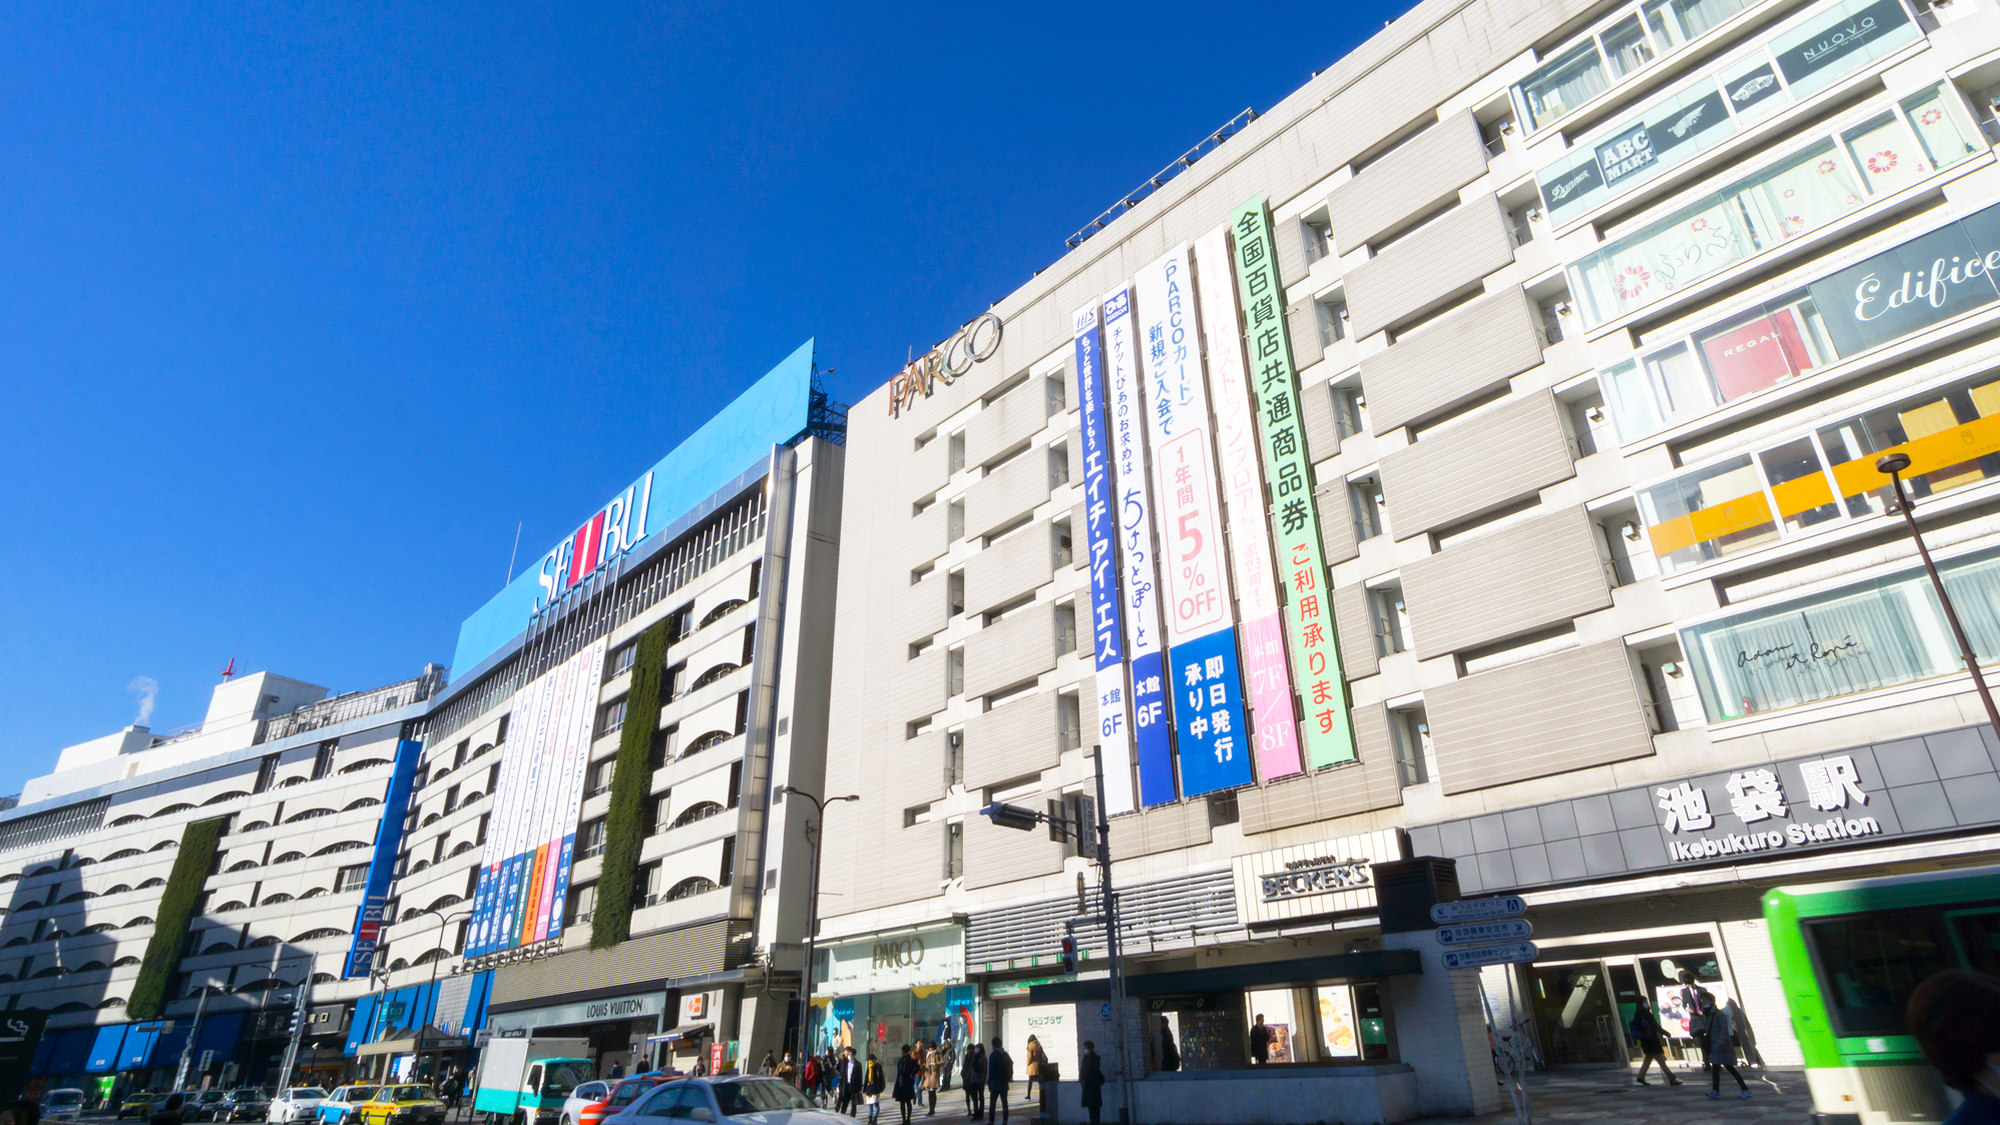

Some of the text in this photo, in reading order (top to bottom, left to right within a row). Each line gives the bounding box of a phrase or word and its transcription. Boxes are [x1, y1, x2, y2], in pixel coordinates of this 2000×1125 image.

[1803, 17, 1875, 61] NUOVO
[1603, 131, 1649, 169] ABC
[1607, 149, 1654, 182] MART
[1855, 250, 2000, 321] Édifice
[888, 312, 1000, 418] PARCO
[1724, 330, 1780, 358] REGAL
[1081, 336, 1096, 451] もっと世界を楽しもう
[1112, 326, 1134, 477] チケットぴあのお求めは
[1148, 321, 1173, 436] 新規ご入会で
[1174, 445, 1195, 510] 1年間
[1237, 210, 1337, 735] 全国百貨店共通商品券 ご利用承ります
[532, 470, 654, 612] SEIBU
[1085, 450, 1117, 663] エイチ・アイ・エス
[1122, 487, 1152, 648] ちけっとぽーと
[1252, 639, 1280, 661] 本館
[1101, 687, 1122, 708] 本館
[1135, 675, 1161, 698] 本館
[1184, 662, 1209, 740] 承り中
[1253, 663, 1283, 695] 7F
[1101, 712, 1123, 738] 6F
[1137, 701, 1163, 728] 6F
[1204, 654, 1235, 764] 即日発行
[1261, 719, 1292, 751] 8F
[1657, 755, 1869, 833] 池袋駅
[1668, 815, 1880, 862] Ikebukuro Station
[1262, 863, 1370, 897] BECKER'S
[353, 895, 386, 965] SEIBU
[872, 937, 924, 970] PARCO
[586, 999, 644, 1018] LOUIS VUITTON
